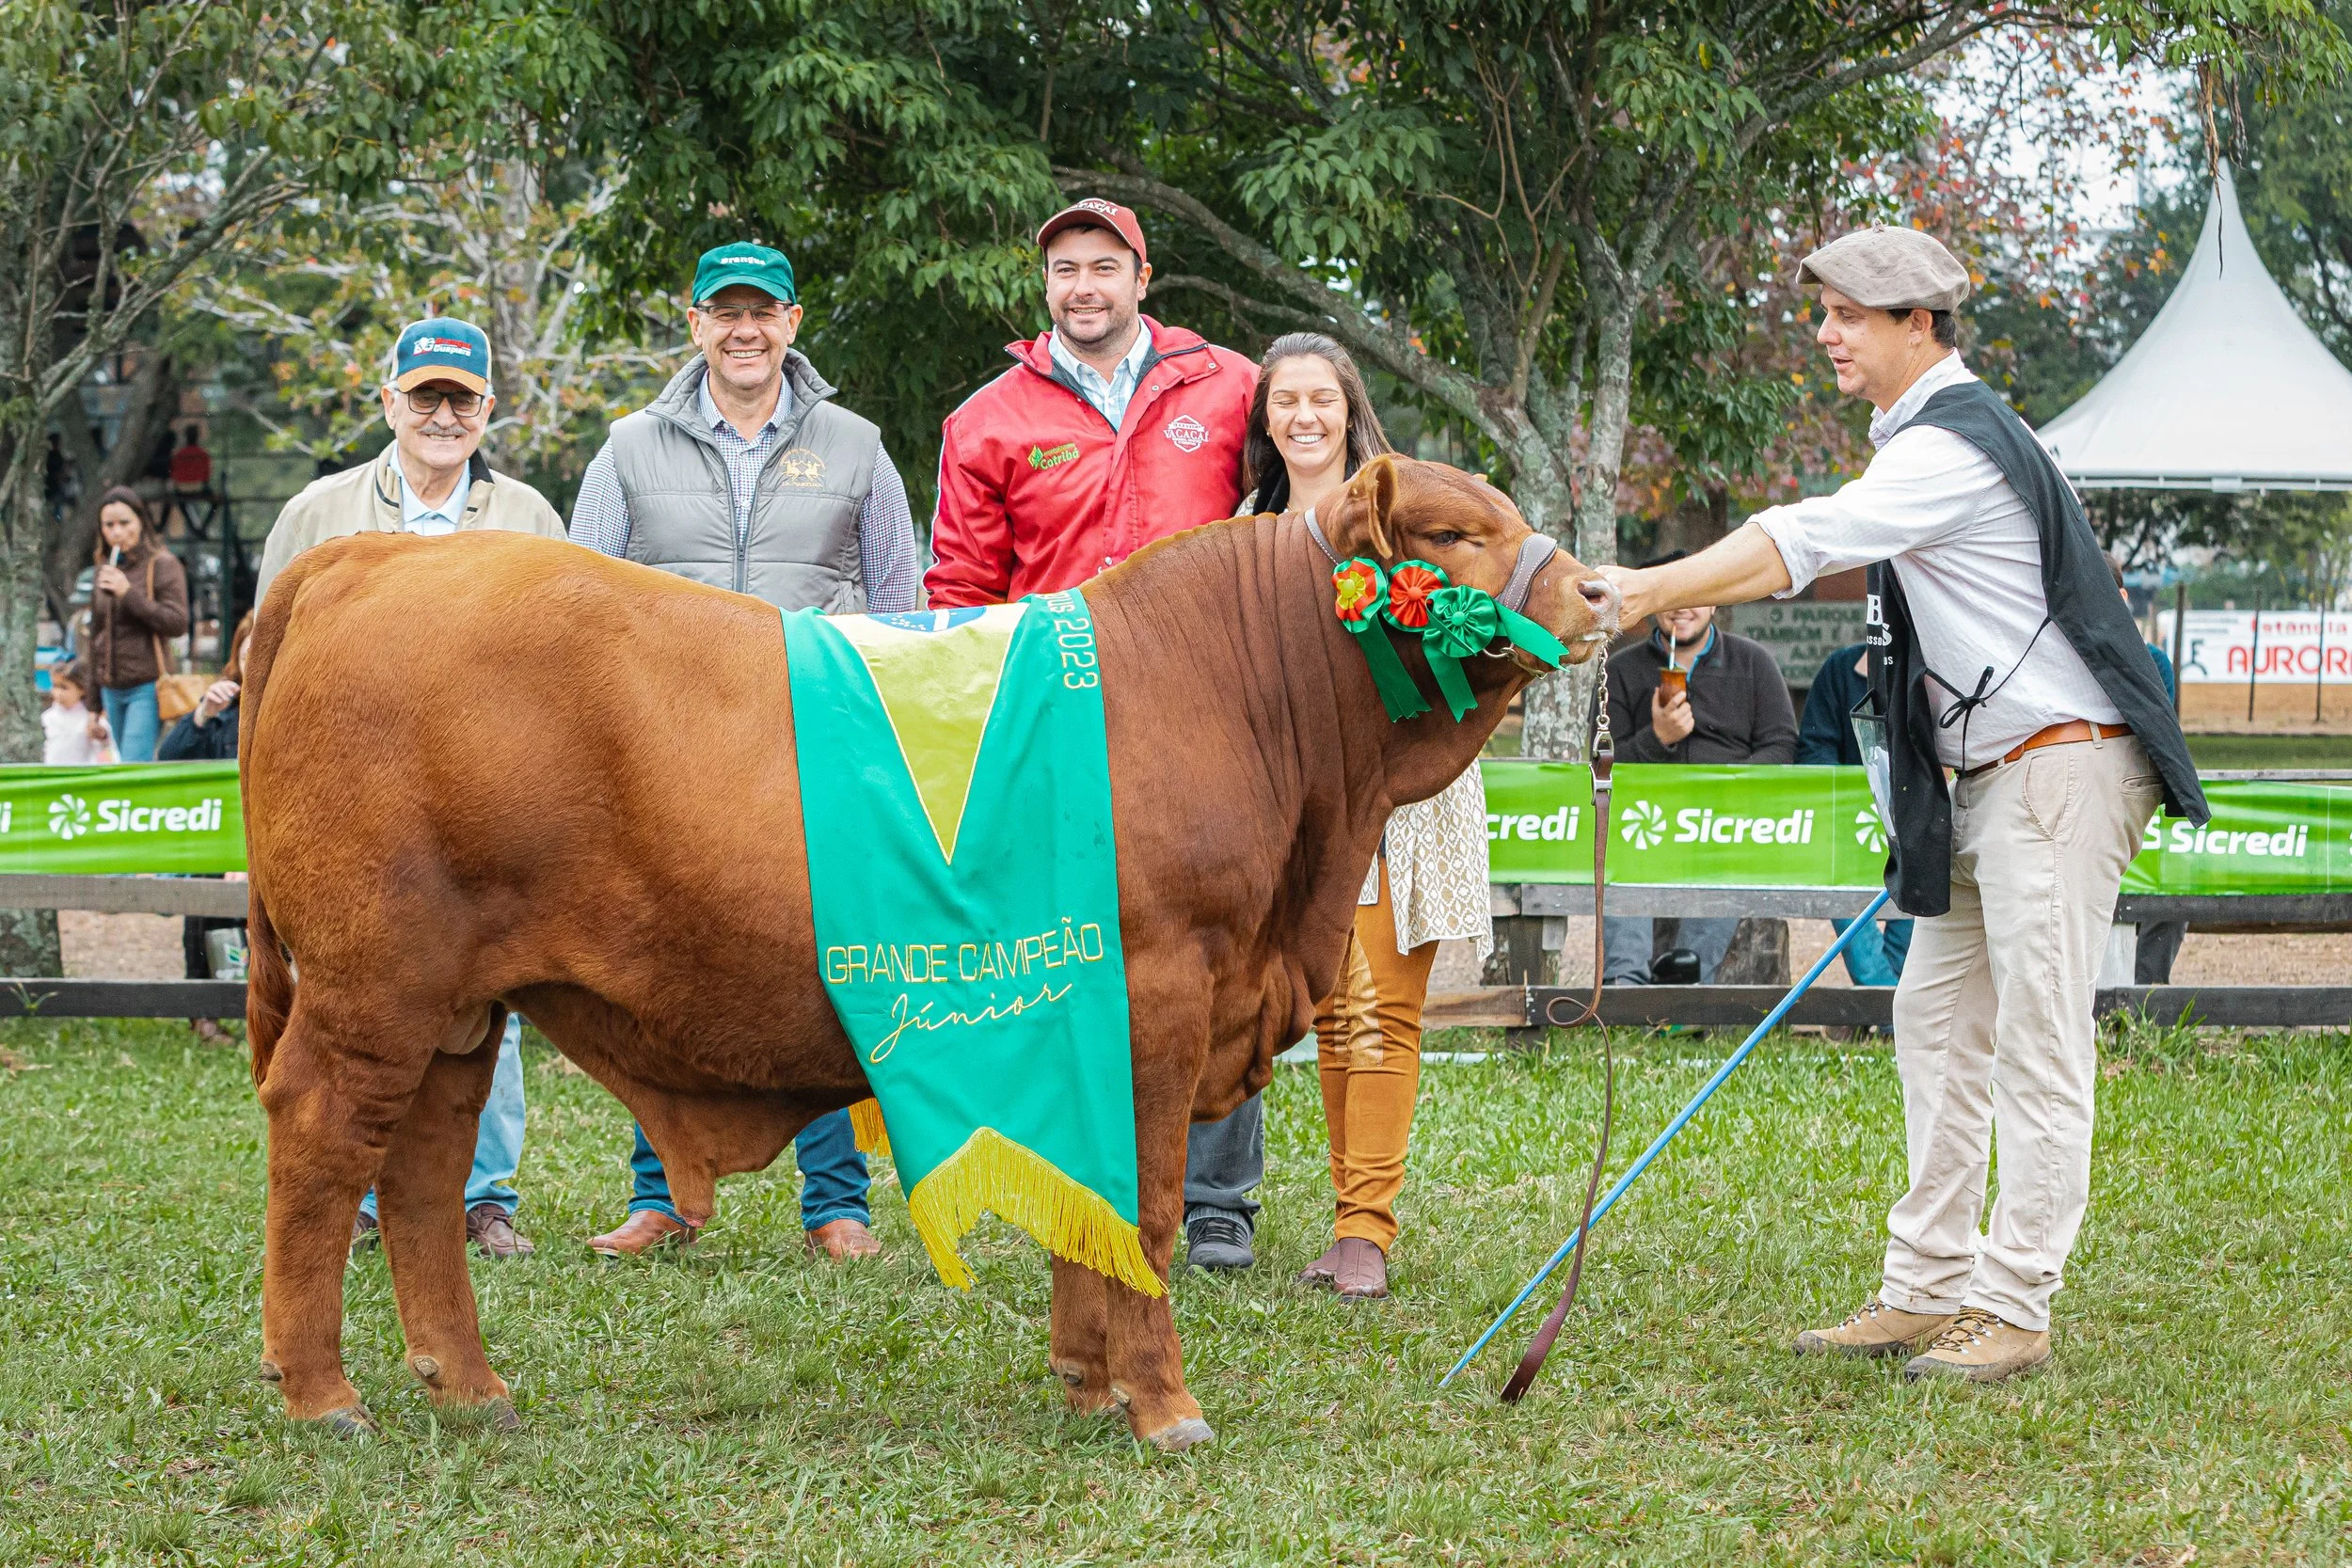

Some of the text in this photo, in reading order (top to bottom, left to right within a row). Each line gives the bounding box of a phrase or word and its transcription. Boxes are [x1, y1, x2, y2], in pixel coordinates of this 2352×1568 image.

[1040, 447, 1079, 470] Cotribá
[1054, 617, 1099, 689] 2023
[2228, 645, 2352, 674] AUROR
[95, 798, 223, 833] Sicredi
[1487, 806, 1580, 841] credi
[1675, 808, 1814, 845] Sicredi
[827, 916, 1104, 984] GRANDE CAMPEÃO
[870, 983, 1073, 1064] Júnior
